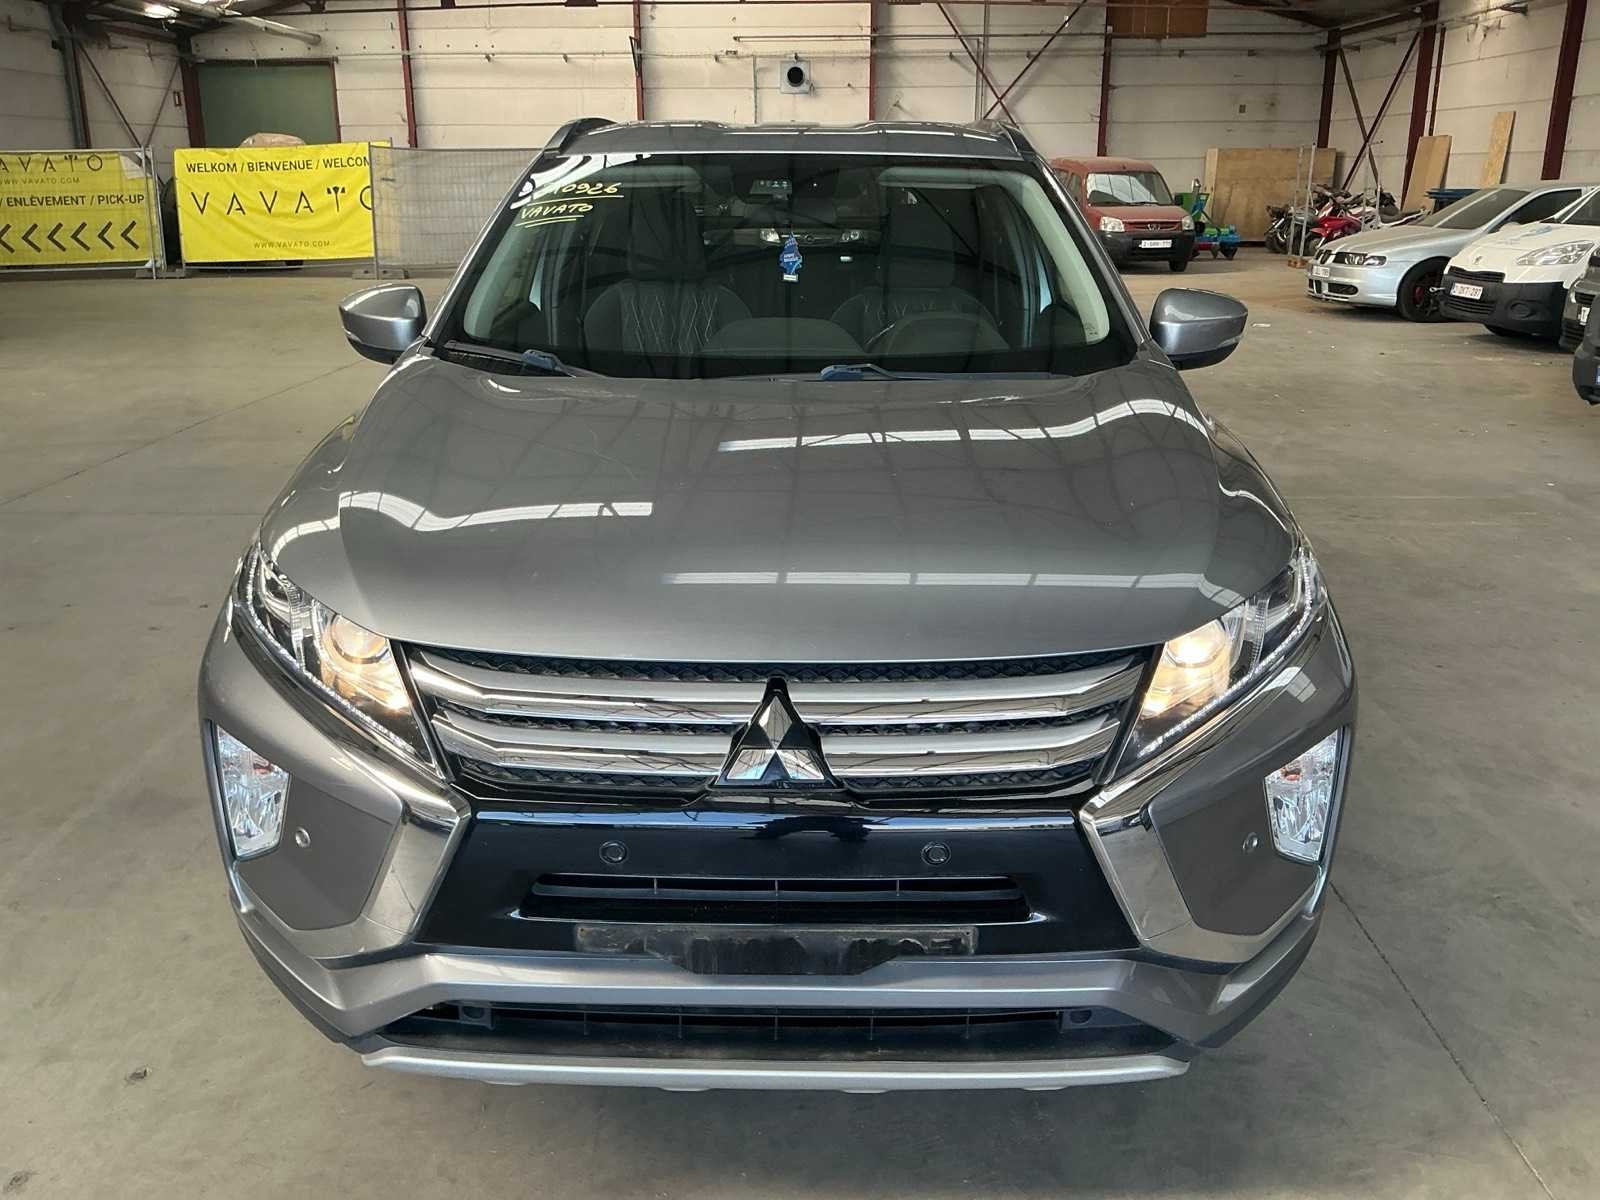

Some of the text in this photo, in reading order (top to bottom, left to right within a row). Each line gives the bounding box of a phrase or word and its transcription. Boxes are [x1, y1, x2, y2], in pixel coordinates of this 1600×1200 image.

[186, 162, 238, 173] WELKOM
[247, 159, 313, 172] BIENVENUE
[97, 193, 145, 205] PICK-UP
[521, 203, 593, 219] VAVATO
[254, 240, 330, 249] WWW.VAVATO.COM
